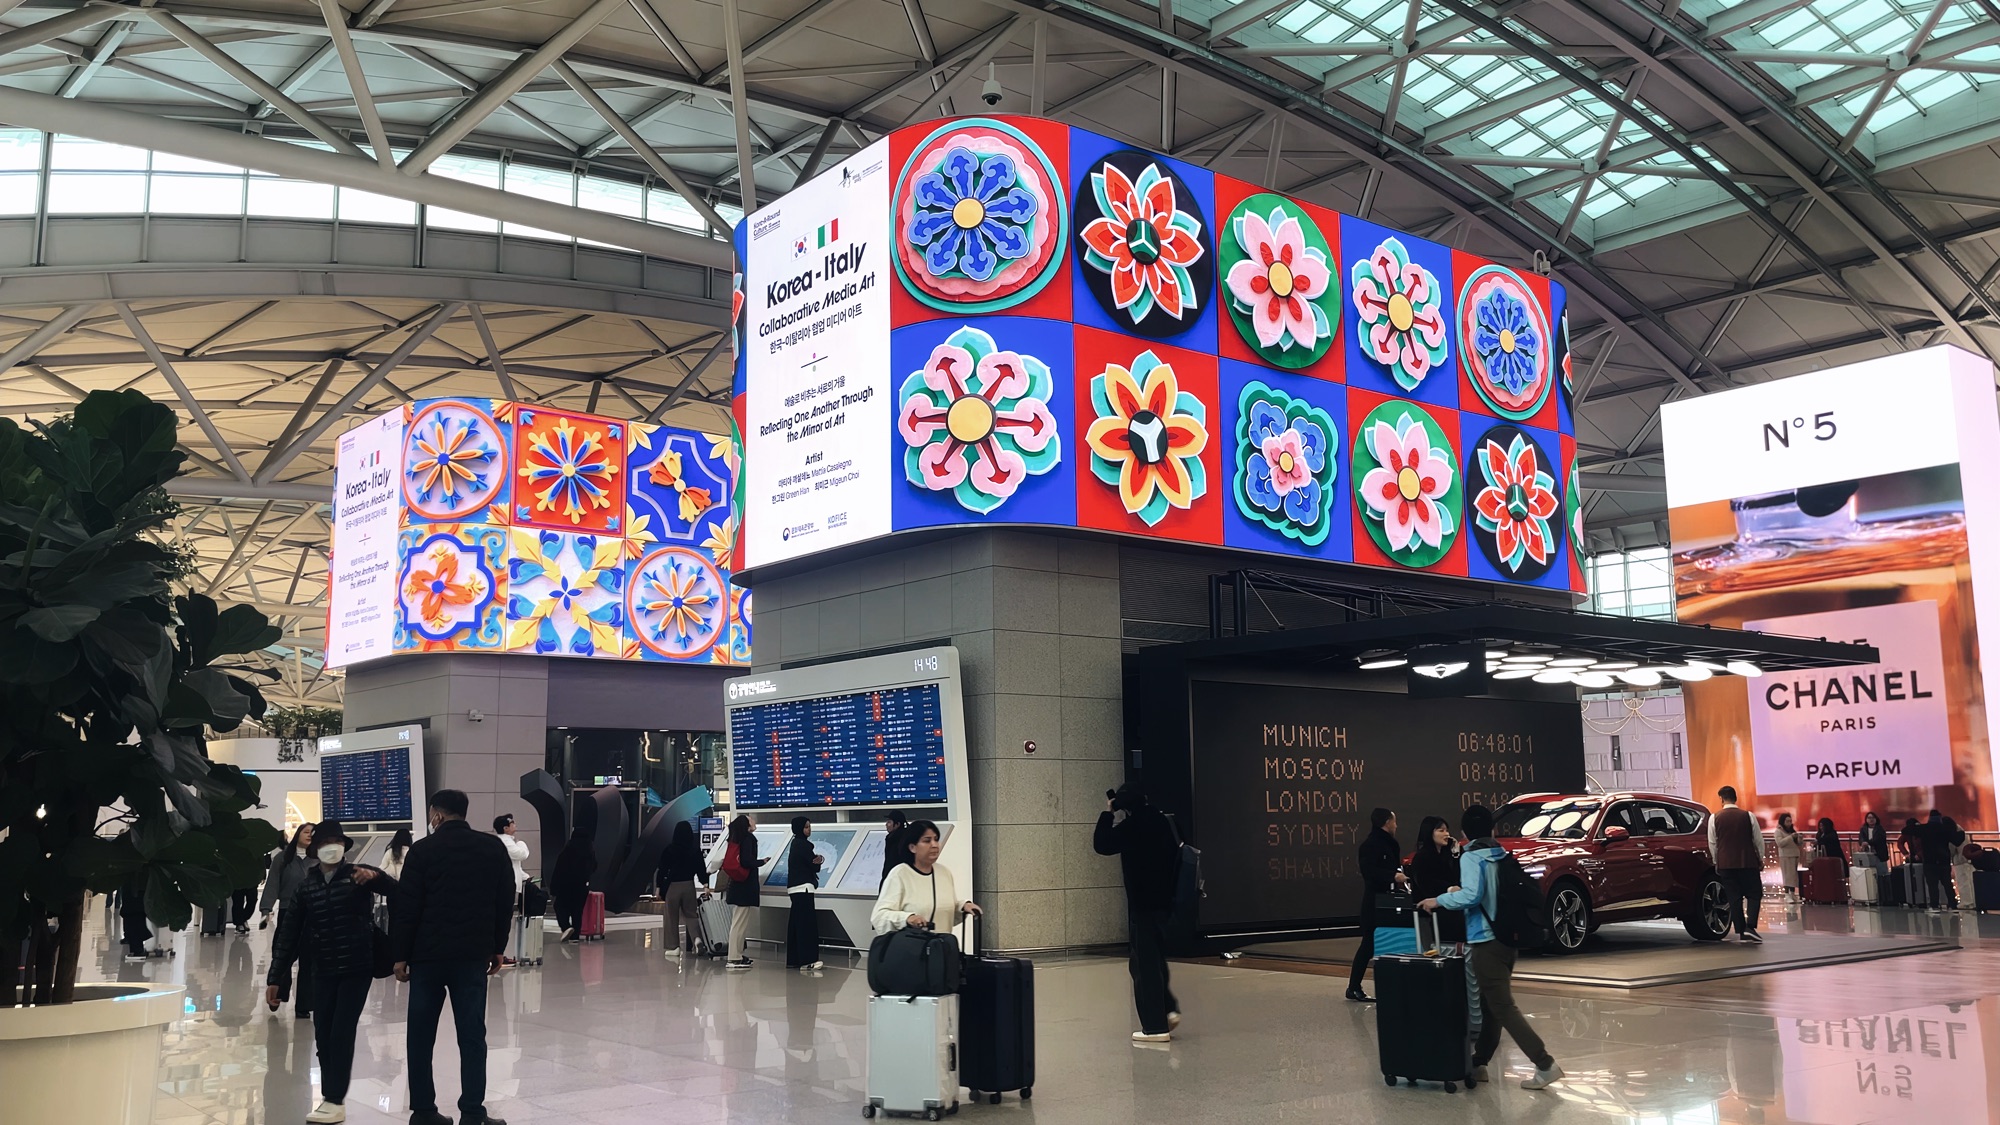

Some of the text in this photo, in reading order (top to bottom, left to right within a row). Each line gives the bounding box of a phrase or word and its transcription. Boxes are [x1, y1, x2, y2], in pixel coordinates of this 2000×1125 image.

[767, 270, 812, 309] Korea
[825, 242, 867, 281] Italy
[759, 271, 875, 337] Collaborative Media Art
[770, 303, 862, 354] 한국-이탈리아 협업 미디어 아트
[801, 388, 816, 401] 비추는
[817, 380, 833, 394] 서로의
[760, 386, 873, 437] Reflecting One Another Through
[787, 412, 845, 443] the Mirror of Art
[805, 451, 823, 465] Artist
[346, 480, 367, 499] Korea
[372, 468, 391, 489] Italy
[1766, 670, 1932, 711] CHANEL
[1263, 724, 1347, 748] MUNICH
[1821, 716, 1876, 733] PARIS
[1458, 732, 1532, 754] 06:48:01
[1264, 757, 1364, 780] MOSCOW
[1460, 762, 1534, 782] 08:48:01
[1806, 759, 1901, 780] PARFUM
[1265, 790, 1358, 812] LONDON
[1268, 823, 1360, 846] SYDNEY
